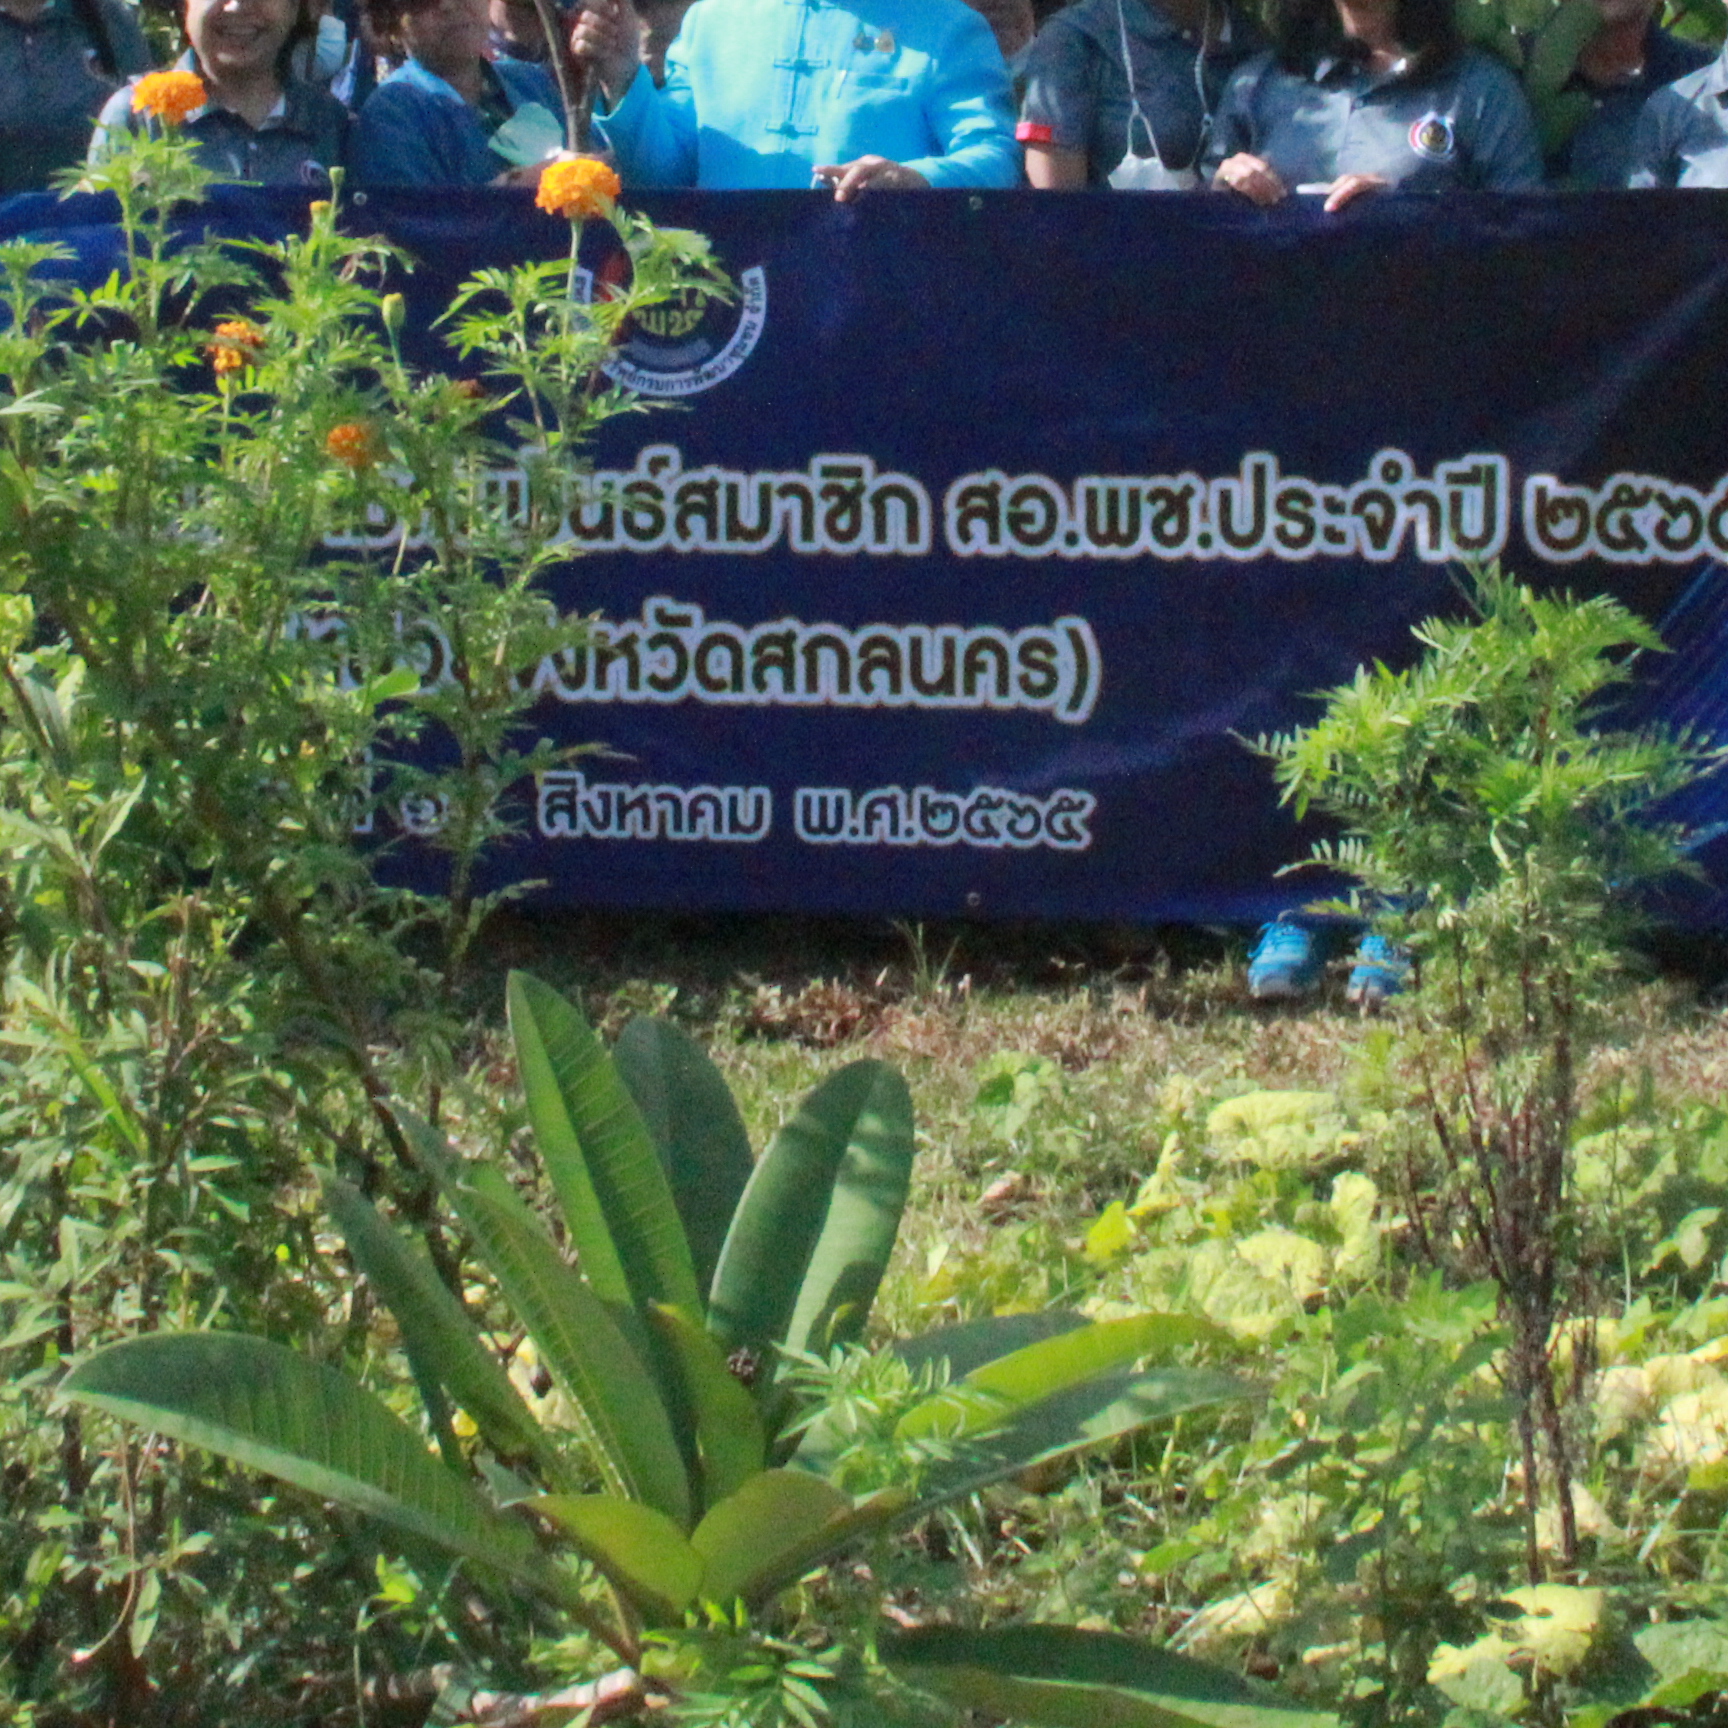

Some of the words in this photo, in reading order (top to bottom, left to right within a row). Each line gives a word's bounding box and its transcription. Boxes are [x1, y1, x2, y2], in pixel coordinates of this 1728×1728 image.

[944, 447, 1511, 563] สอ.พช.ประจำปี
[535, 769, 772, 842] สิงหาคม
[793, 784, 1096, 852] พ.ศ.๒๕๖๕
